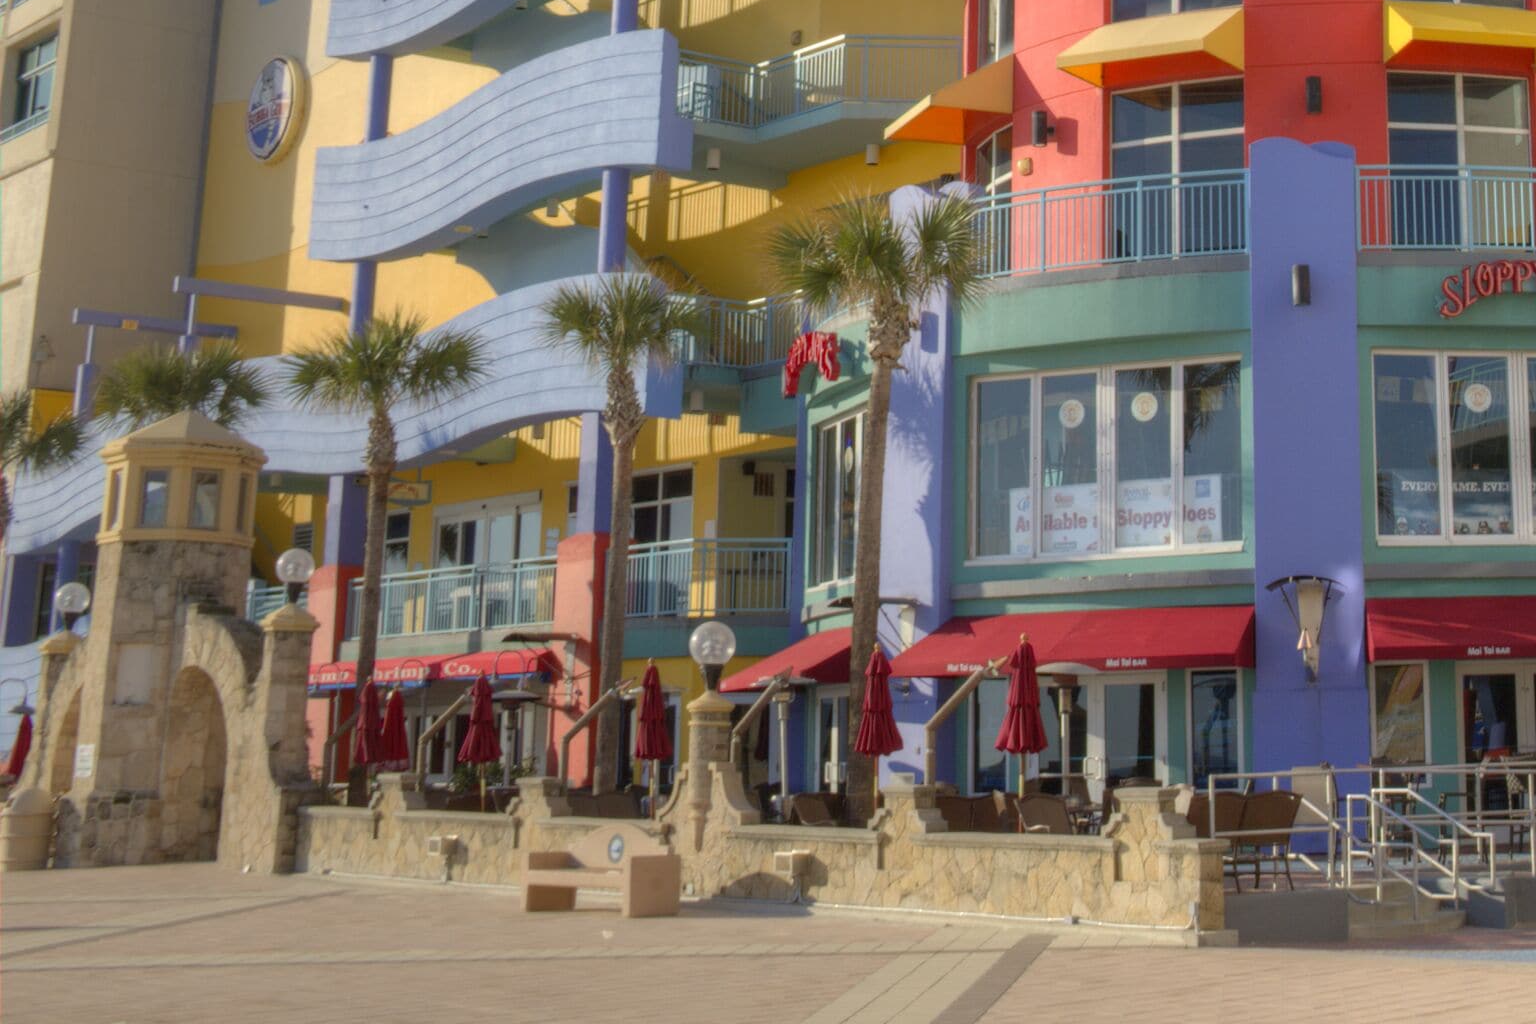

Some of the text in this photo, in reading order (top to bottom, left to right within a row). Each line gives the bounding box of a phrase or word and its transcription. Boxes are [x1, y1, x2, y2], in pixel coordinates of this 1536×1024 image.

[1467, 646, 1482, 656] Mai
[1484, 645, 1494, 656] Tai
[1106, 658, 1120, 667] Mai
[1121, 657, 1131, 666] Tai
[309, 661, 477, 682] ump hrimp Co.
